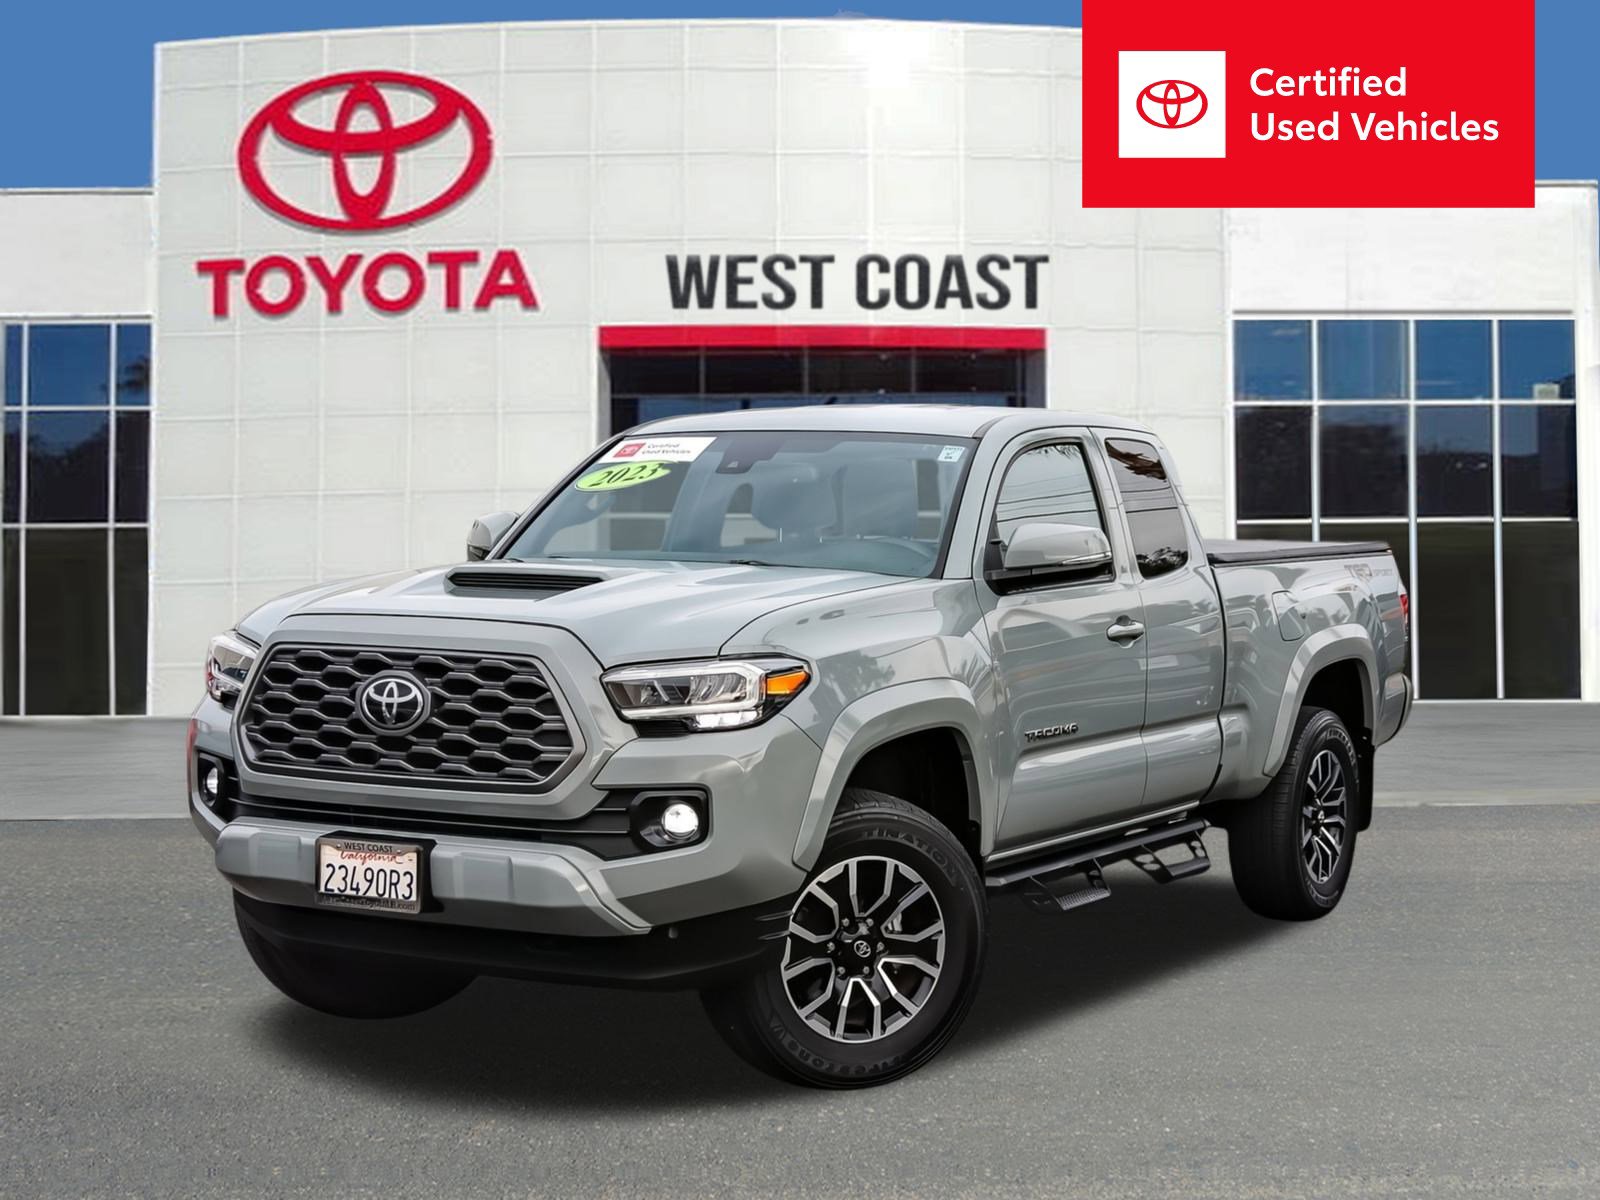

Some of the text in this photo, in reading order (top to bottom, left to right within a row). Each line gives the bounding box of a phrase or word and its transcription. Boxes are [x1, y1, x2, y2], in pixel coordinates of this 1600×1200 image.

[197, 250, 538, 318] TOYOTA
[666, 254, 1049, 310] WEST COAST
[589, 463, 666, 487] 2023
[1025, 723, 1078, 742] TACOMA
[340, 850, 403, 865] California
[344, 842, 393, 853] WEST COAST
[324, 863, 414, 900] 23490R3
